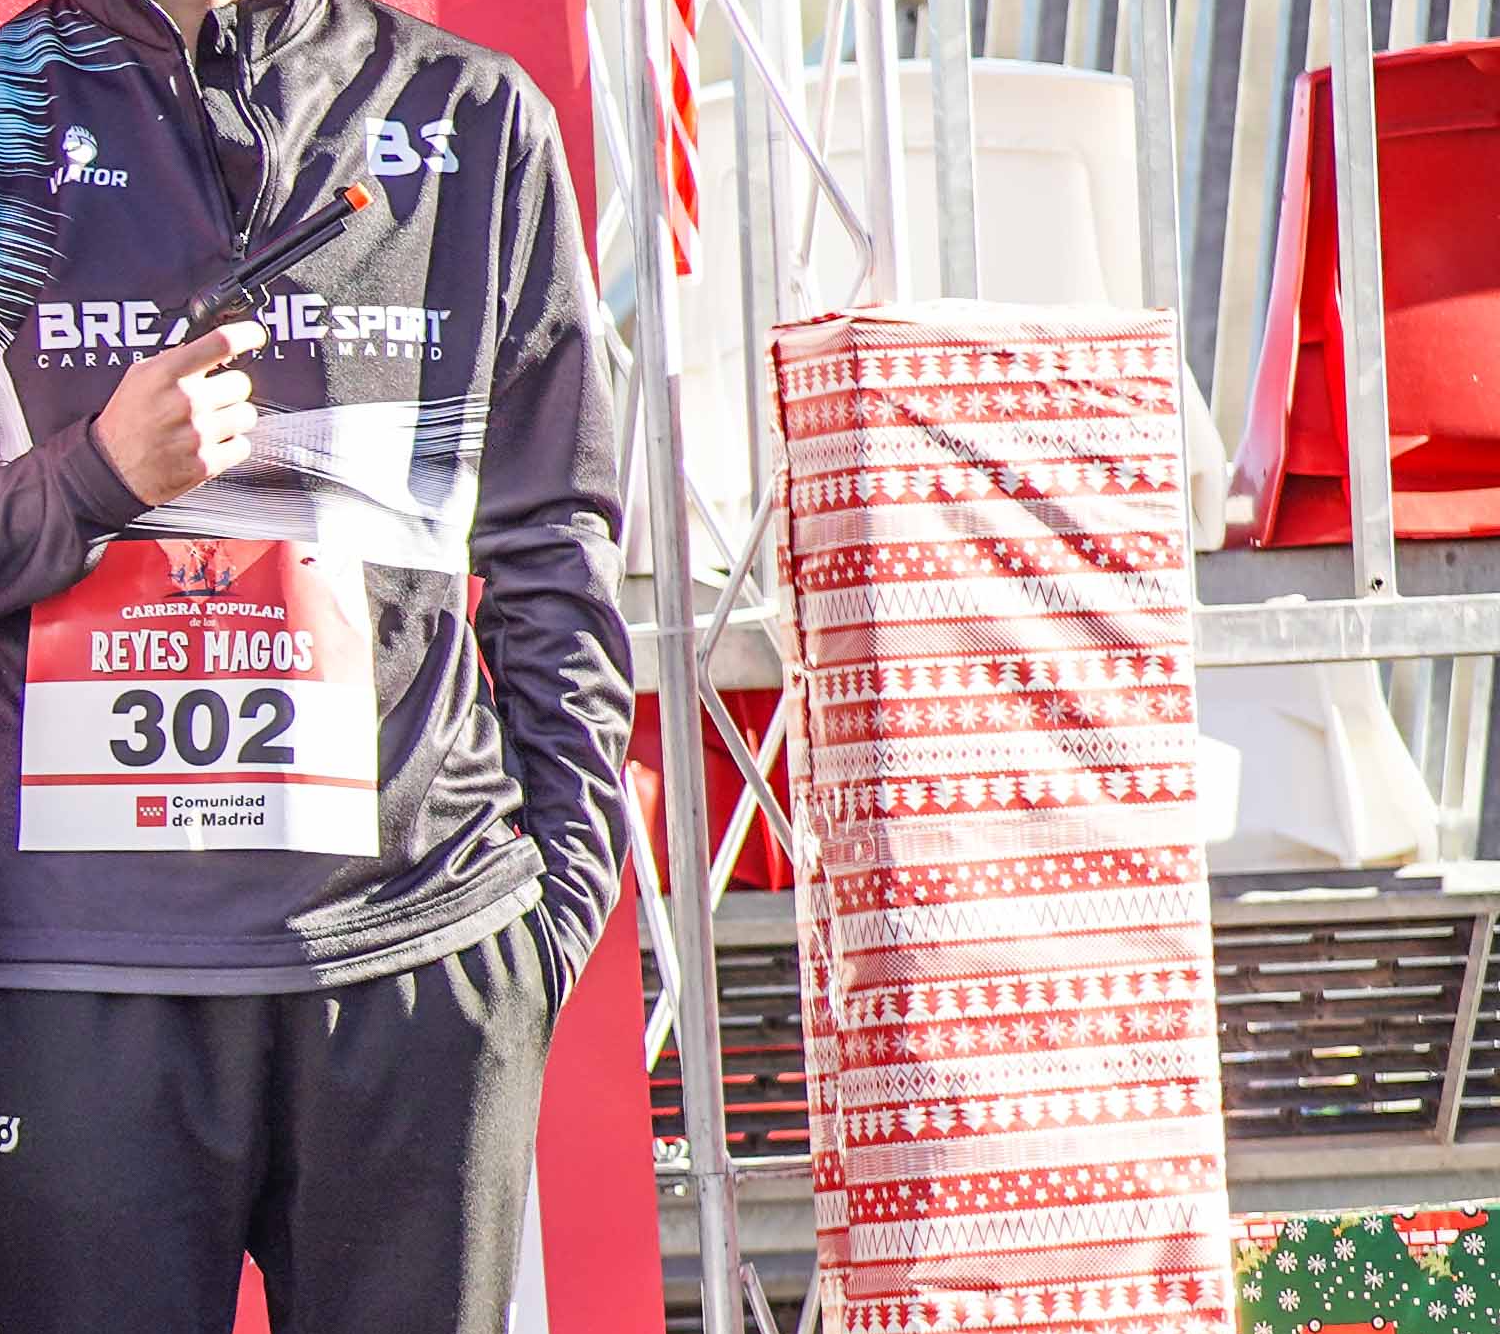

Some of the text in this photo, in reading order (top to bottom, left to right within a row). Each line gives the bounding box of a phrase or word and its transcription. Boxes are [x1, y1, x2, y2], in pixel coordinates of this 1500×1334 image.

[122, 603, 285, 620] CARRERA POPULAR
[91, 629, 314, 673] REYES MAGOS
[110, 688, 295, 766] 302
[172, 795, 266, 809] Comunidad
[172, 812, 265, 827] de Madrid
